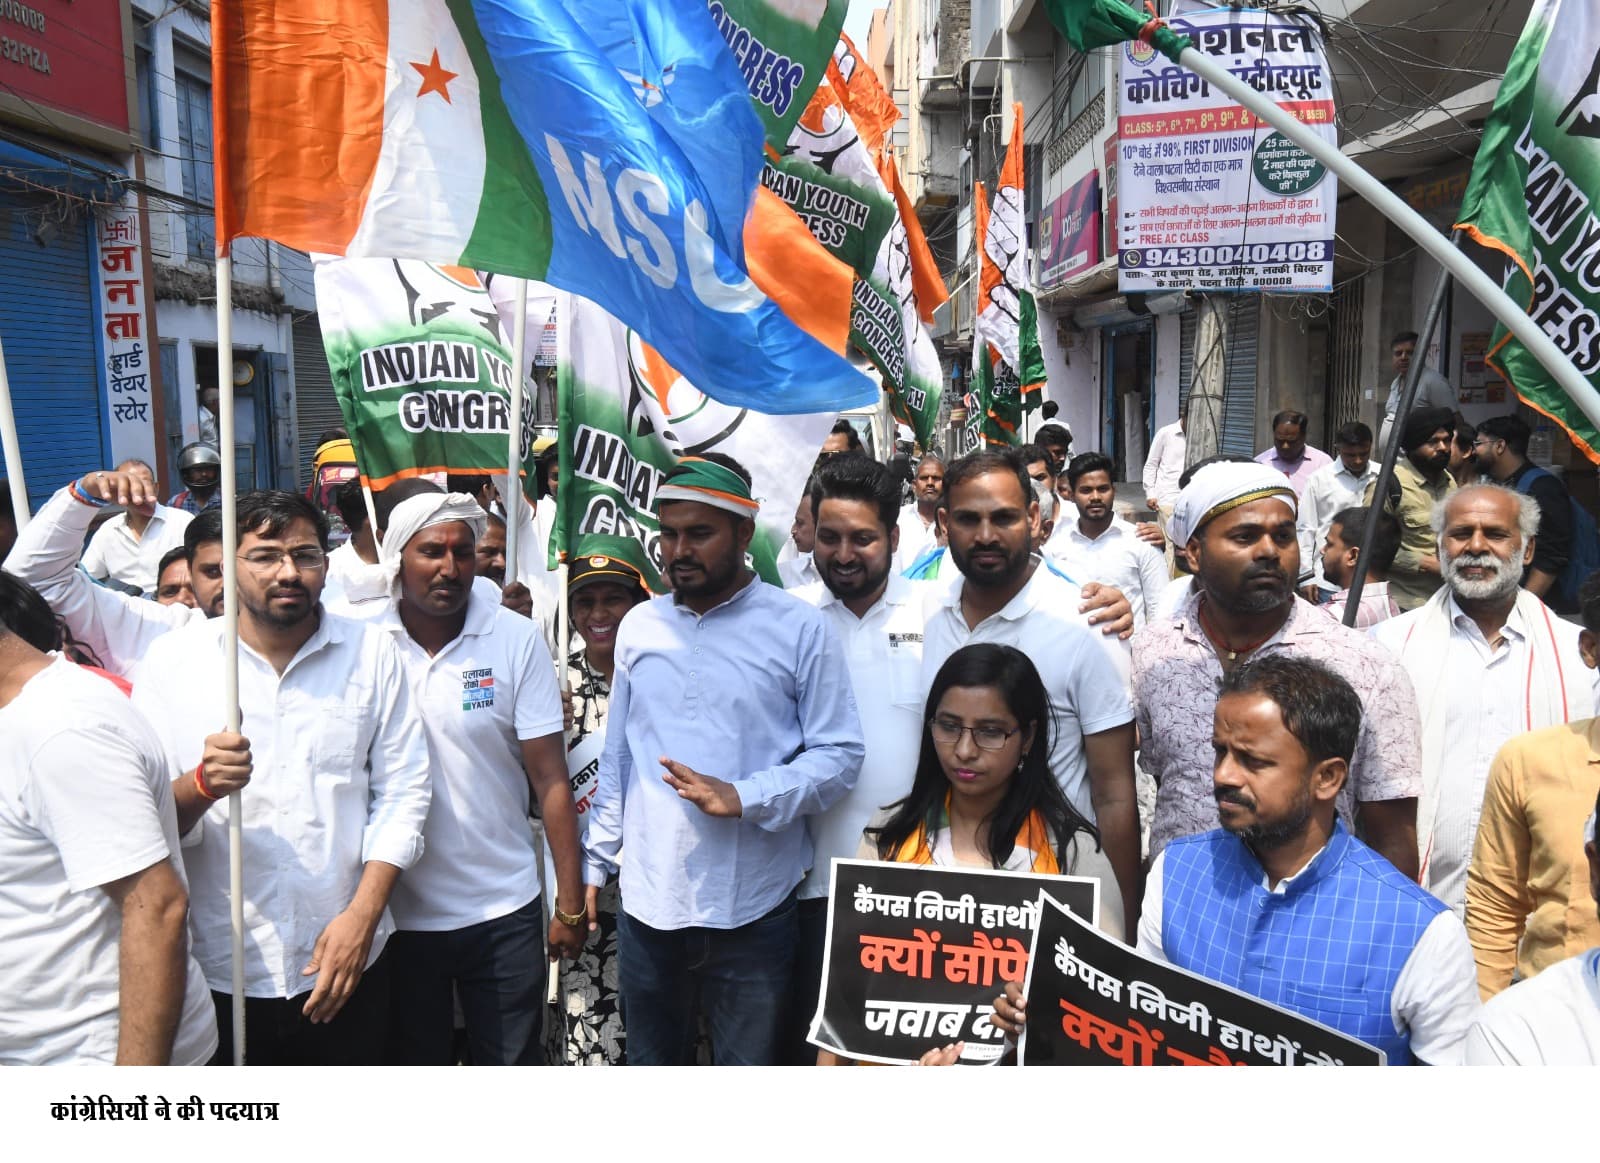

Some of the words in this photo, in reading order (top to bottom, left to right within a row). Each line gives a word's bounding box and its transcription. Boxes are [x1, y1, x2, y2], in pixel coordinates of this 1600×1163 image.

[0, 34, 52, 76] 32F1ZA
[1124, 121, 1154, 135] CLASS:
[1241, 109, 1249, 125] &
[1162, 141, 1181, 158] 98%
[1183, 140, 1210, 156] FIRST
[1213, 135, 1255, 154] DIVISION
[1265, 138, 1277, 149] 25
[1146, 164, 1163, 176] वाला
[1164, 163, 1183, 175] पटना
[1184, 159, 1200, 174] सिटी
[1201, 161, 1212, 173] का
[1213, 160, 1226, 173] एक
[1227, 158, 1243, 171] मात्र
[1263, 160, 1269, 170] 2
[804, 183, 870, 229] YOUTH
[1139, 234, 1163, 245] FREE
[1165, 233, 1177, 244] AC
[1180, 232, 1210, 243] CLASS
[1145, 241, 1325, 267] 9430040408
[1199, 279, 1222, 288] पटना
[1252, 276, 1293, 287] 800008
[854, 280, 899, 336] INDIAN
[361, 342, 478, 390] INDIAN
[110, 372, 147, 394] वेयर
[113, 396, 148, 424] स्टोर
[462, 668, 492, 680] पलायन
[471, 699, 494, 711] YATRA
[853, 884, 911, 918] कैंपस
[914, 890, 976, 925] निजी
[980, 899, 1040, 931] हाथों
[859, 928, 942, 979] क्यों
[1054, 936, 1123, 1003] कैंपस
[1127, 980, 1212, 1037] निजी
[1216, 1018, 1302, 1066] हाथों
[865, 999, 972, 1038] जवाब
[1060, 998, 1165, 1066] क्यों
